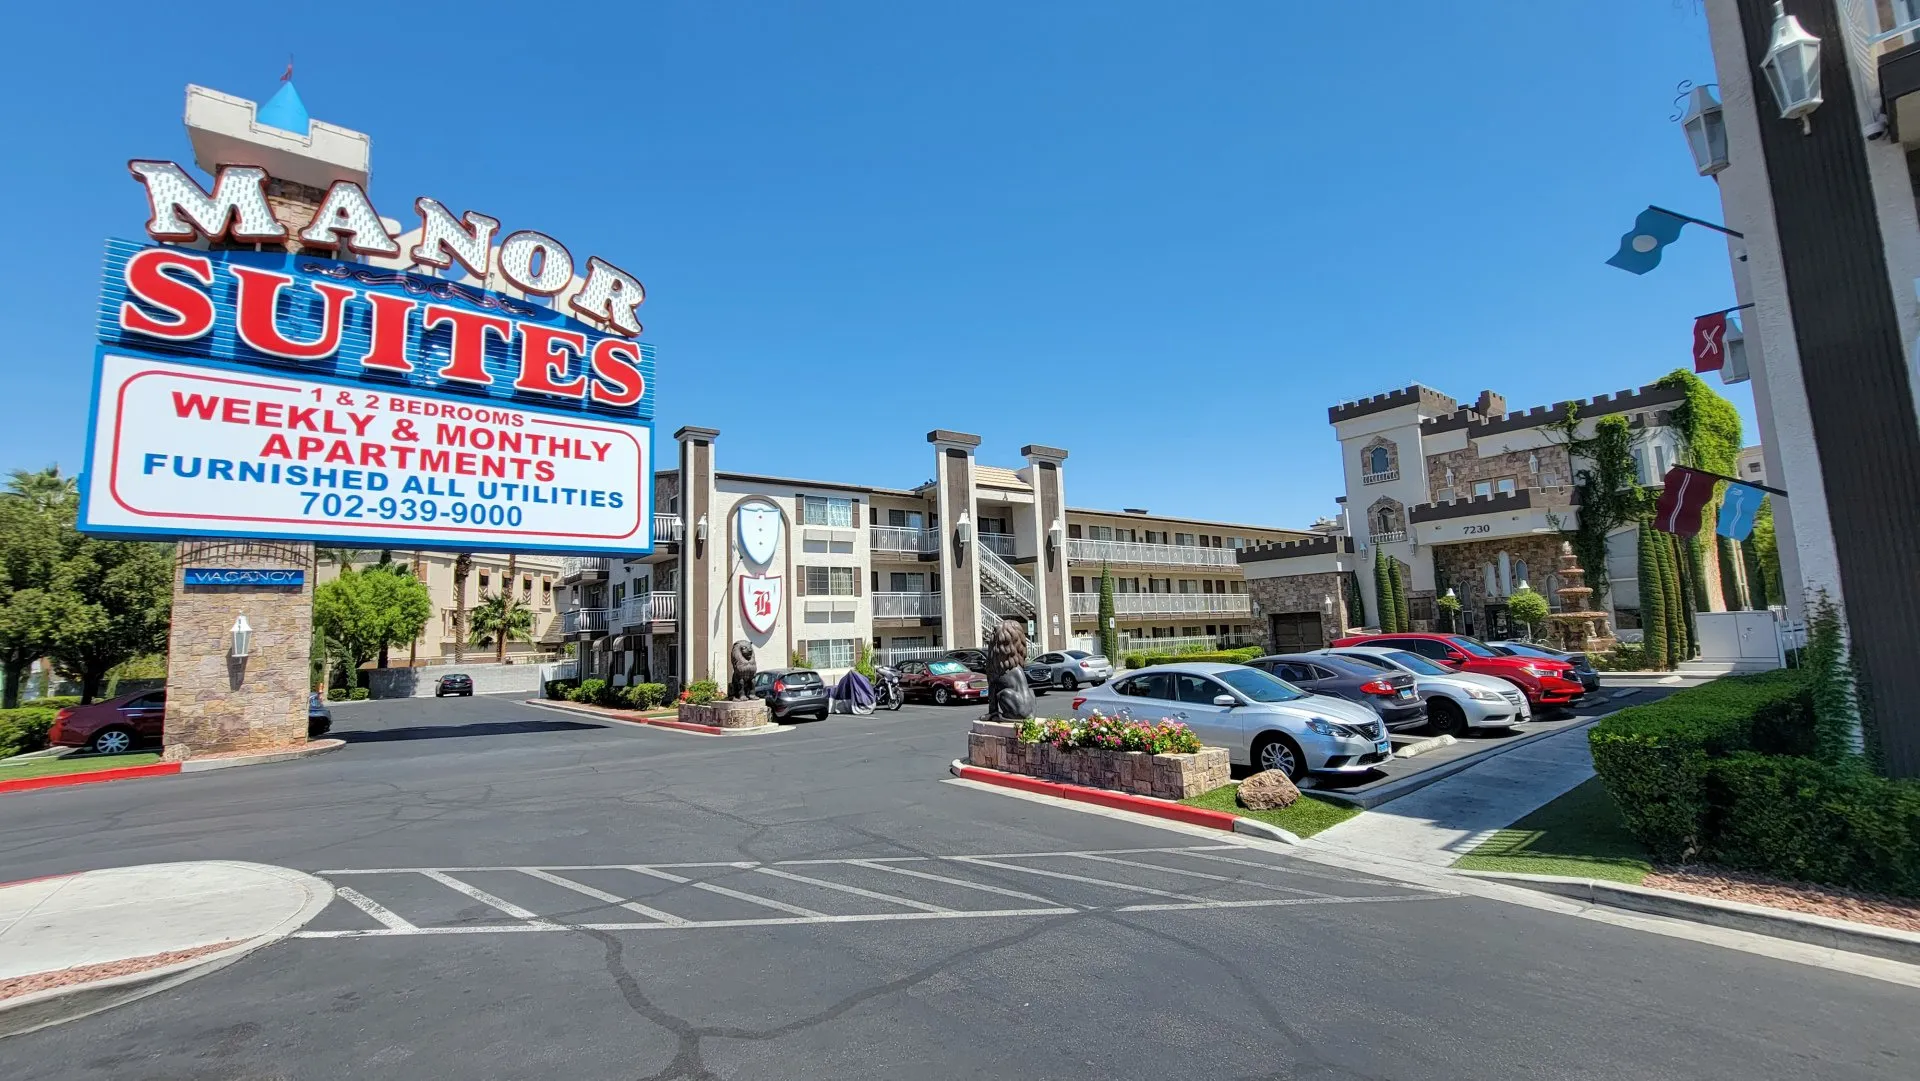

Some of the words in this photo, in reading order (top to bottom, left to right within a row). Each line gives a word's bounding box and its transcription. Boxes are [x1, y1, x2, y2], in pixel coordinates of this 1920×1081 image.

[127, 159, 646, 336] MANOR
[120, 248, 644, 407] SUITES
[171, 391, 375, 436] WEEKLY
[392, 416, 420, 442] &
[436, 423, 612, 462] MONTHLY
[312, 388, 322, 403] 1
[336, 389, 354, 407] &
[366, 393, 380, 410] 2
[389, 397, 524, 426] BEDROOMS
[143, 453, 388, 491] FURNISHED
[401, 474, 465, 497] ALL
[477, 481, 623, 508] UTILITIES
[259, 433, 556, 481] APARTMENTS
[300, 491, 522, 526] 702-939-9000
[1463, 524, 1490, 535] 7230
[195, 571, 296, 582] VACANCY
